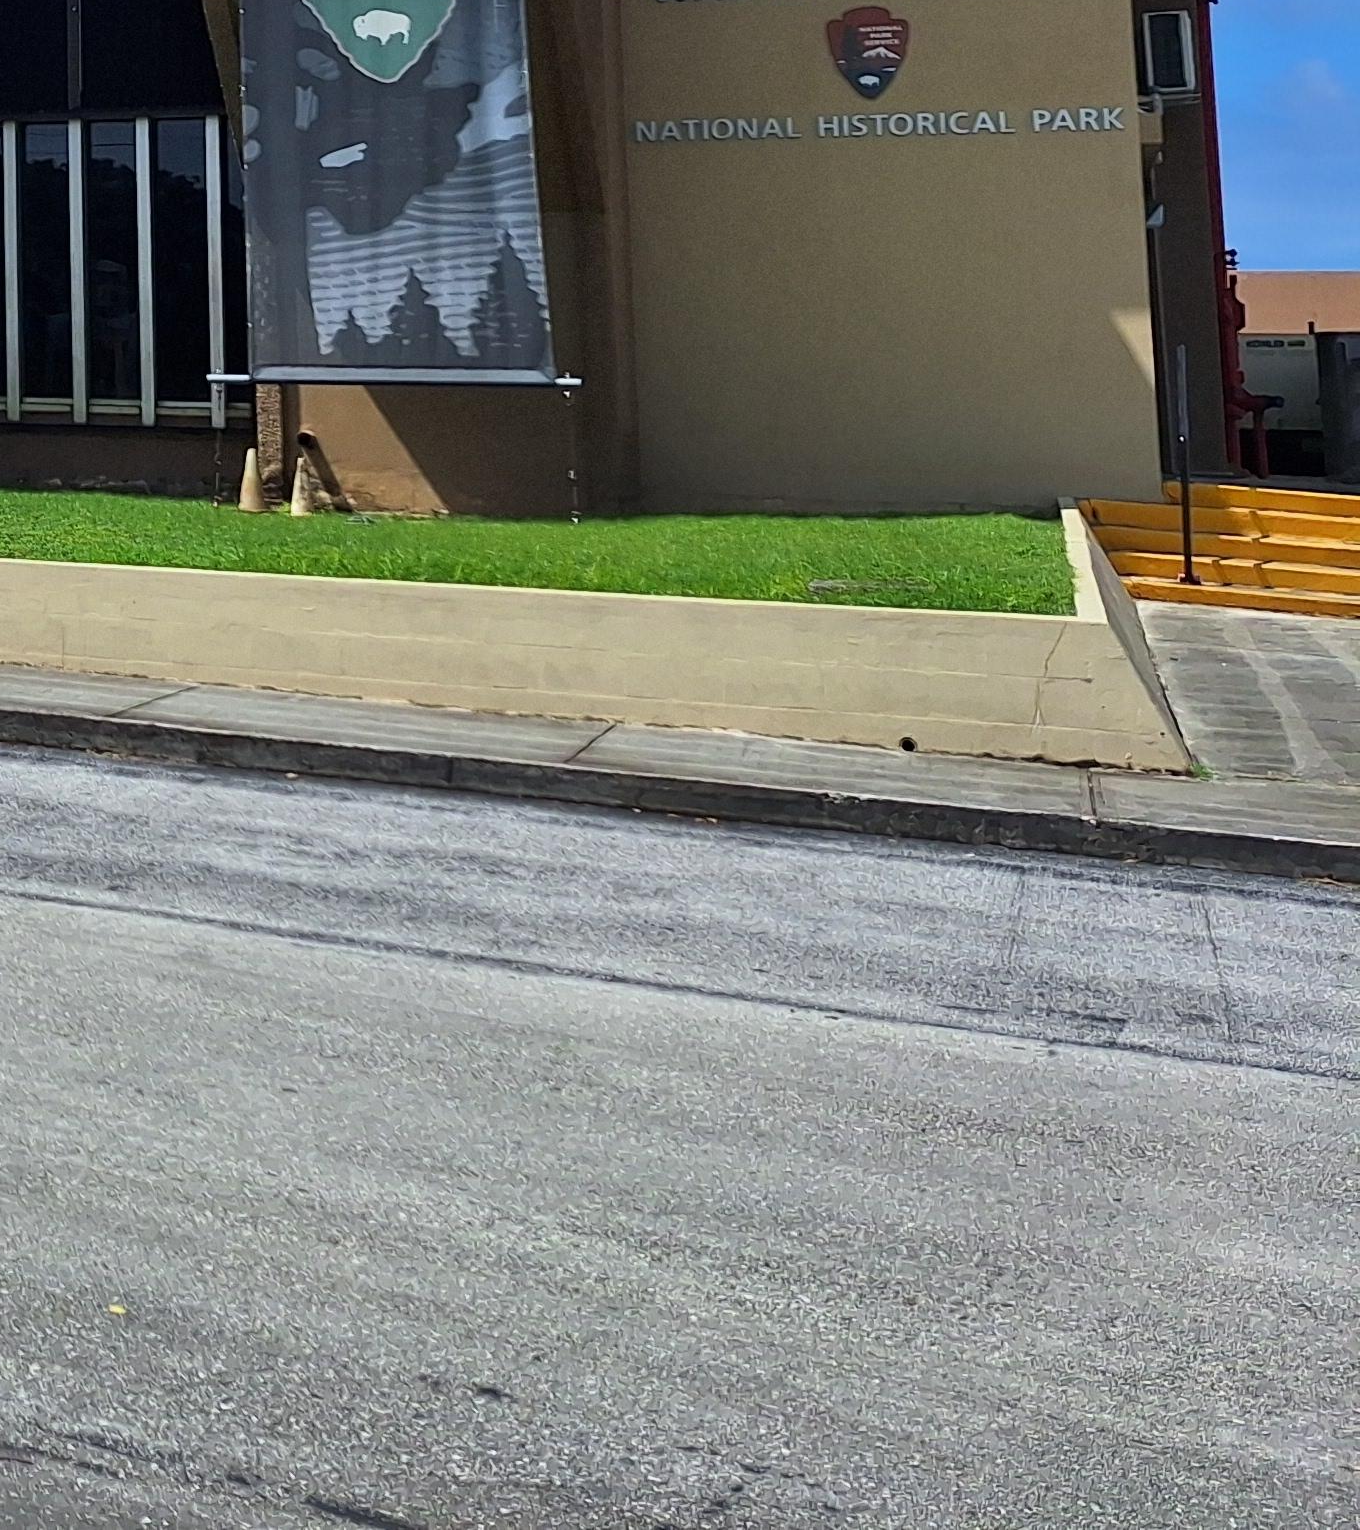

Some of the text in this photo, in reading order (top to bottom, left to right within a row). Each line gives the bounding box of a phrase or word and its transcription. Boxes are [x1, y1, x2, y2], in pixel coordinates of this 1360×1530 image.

[635, 107, 1125, 142] NATIONAL HISTORICAL PARK
